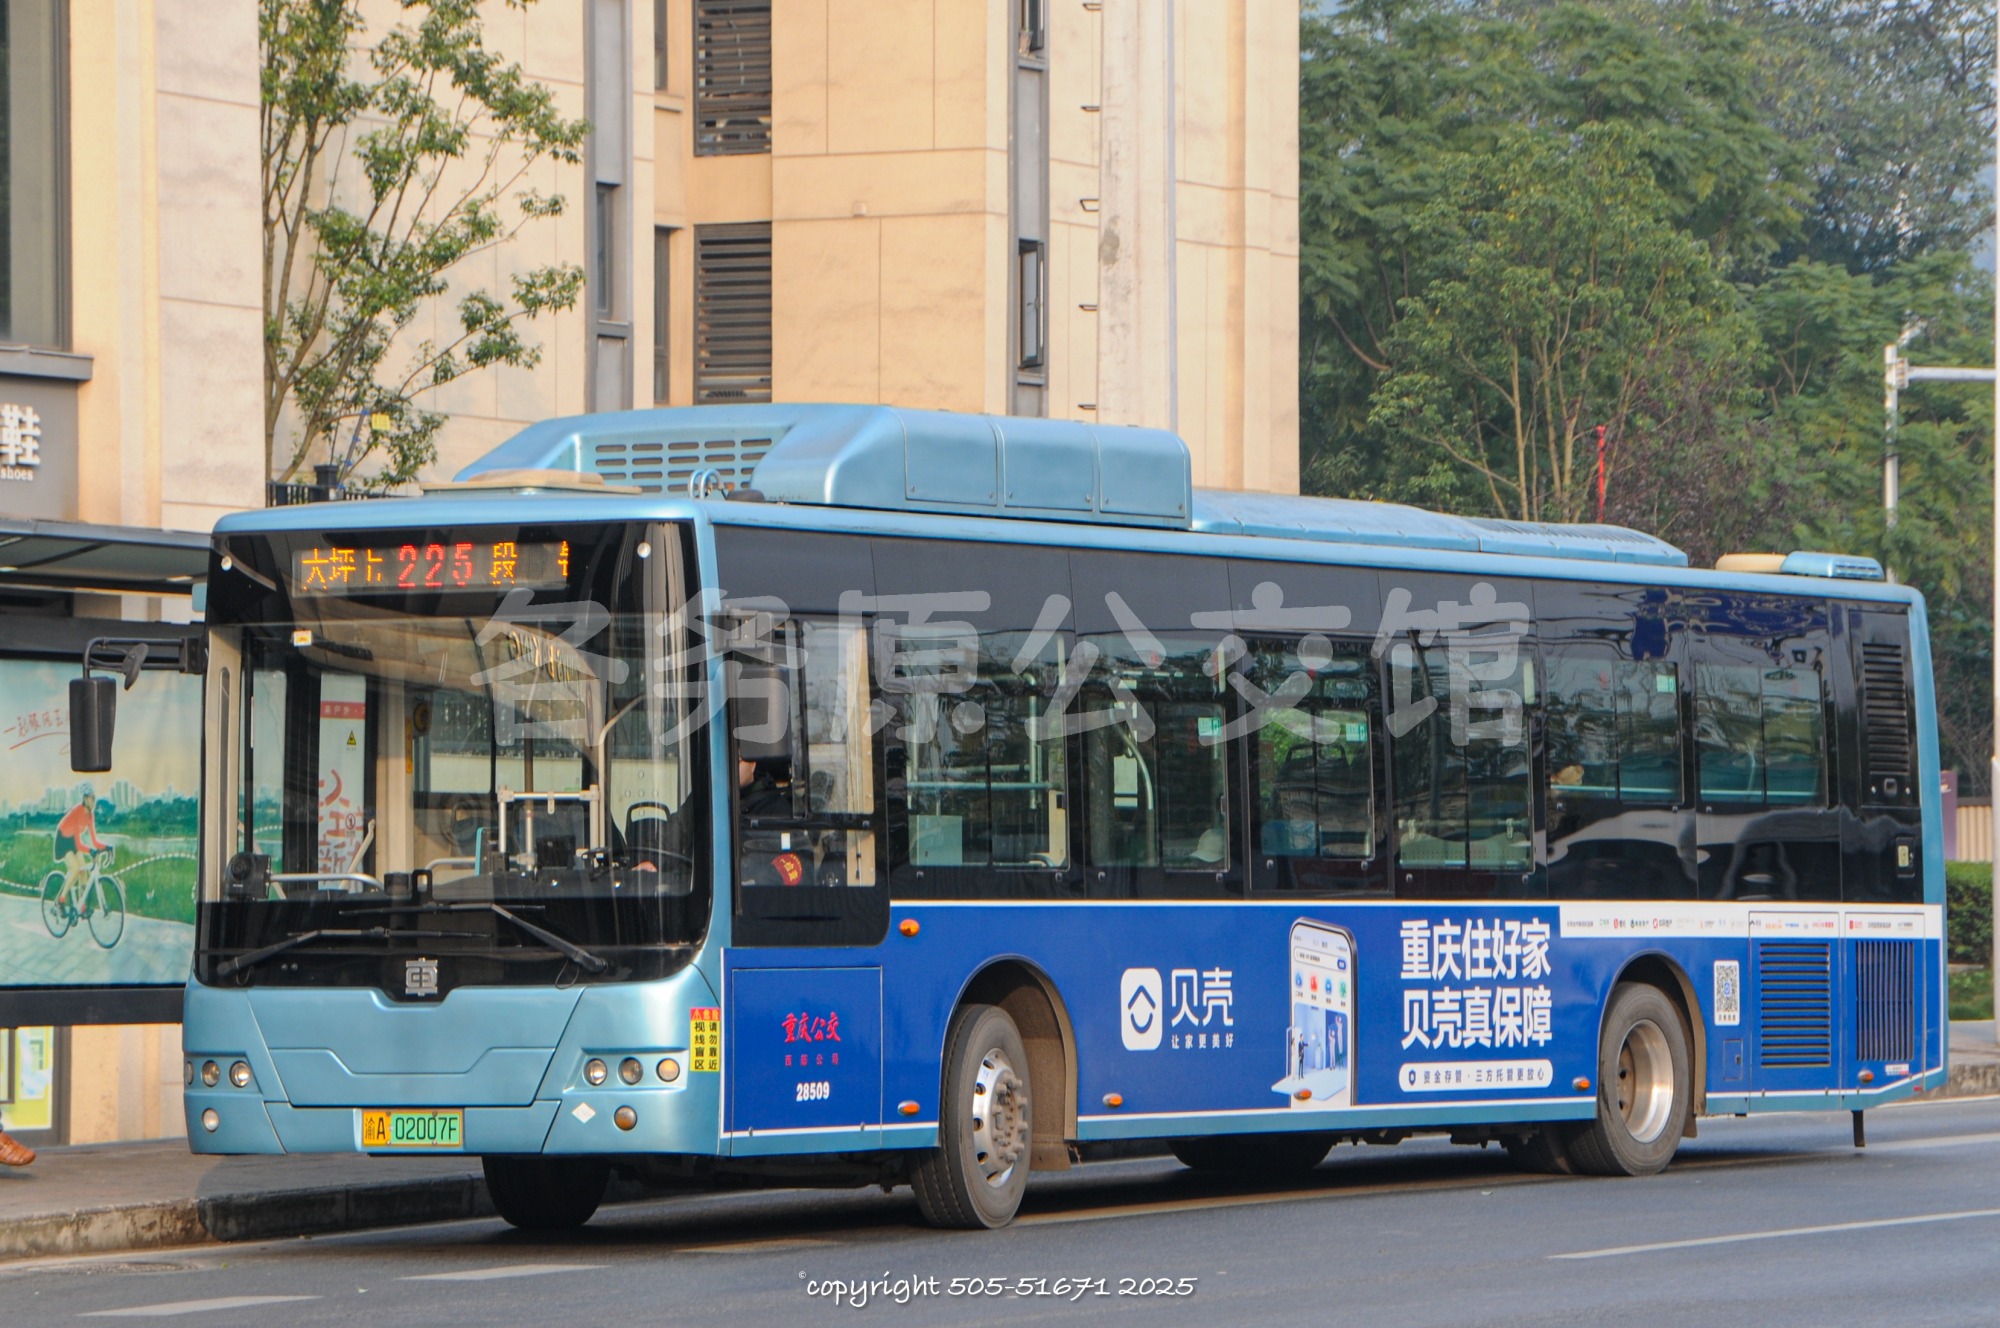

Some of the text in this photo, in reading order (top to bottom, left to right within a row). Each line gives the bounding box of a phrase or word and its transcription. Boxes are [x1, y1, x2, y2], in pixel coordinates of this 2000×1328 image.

[0, 404, 41, 466] 鞋
[0, 466, 33, 480] shoes
[398, 544, 473, 588] 225
[1400, 918, 1551, 981] 重庆住好家
[1171, 967, 1234, 1027] 贝壳
[1401, 984, 1553, 1050] 贝壳真保障
[694, 1021, 705, 1071] 视线盲区
[708, 1021, 718, 1071] 请勿靠近
[1171, 1033, 1234, 1050] 让家更美好
[796, 1081, 830, 1102] 28509
